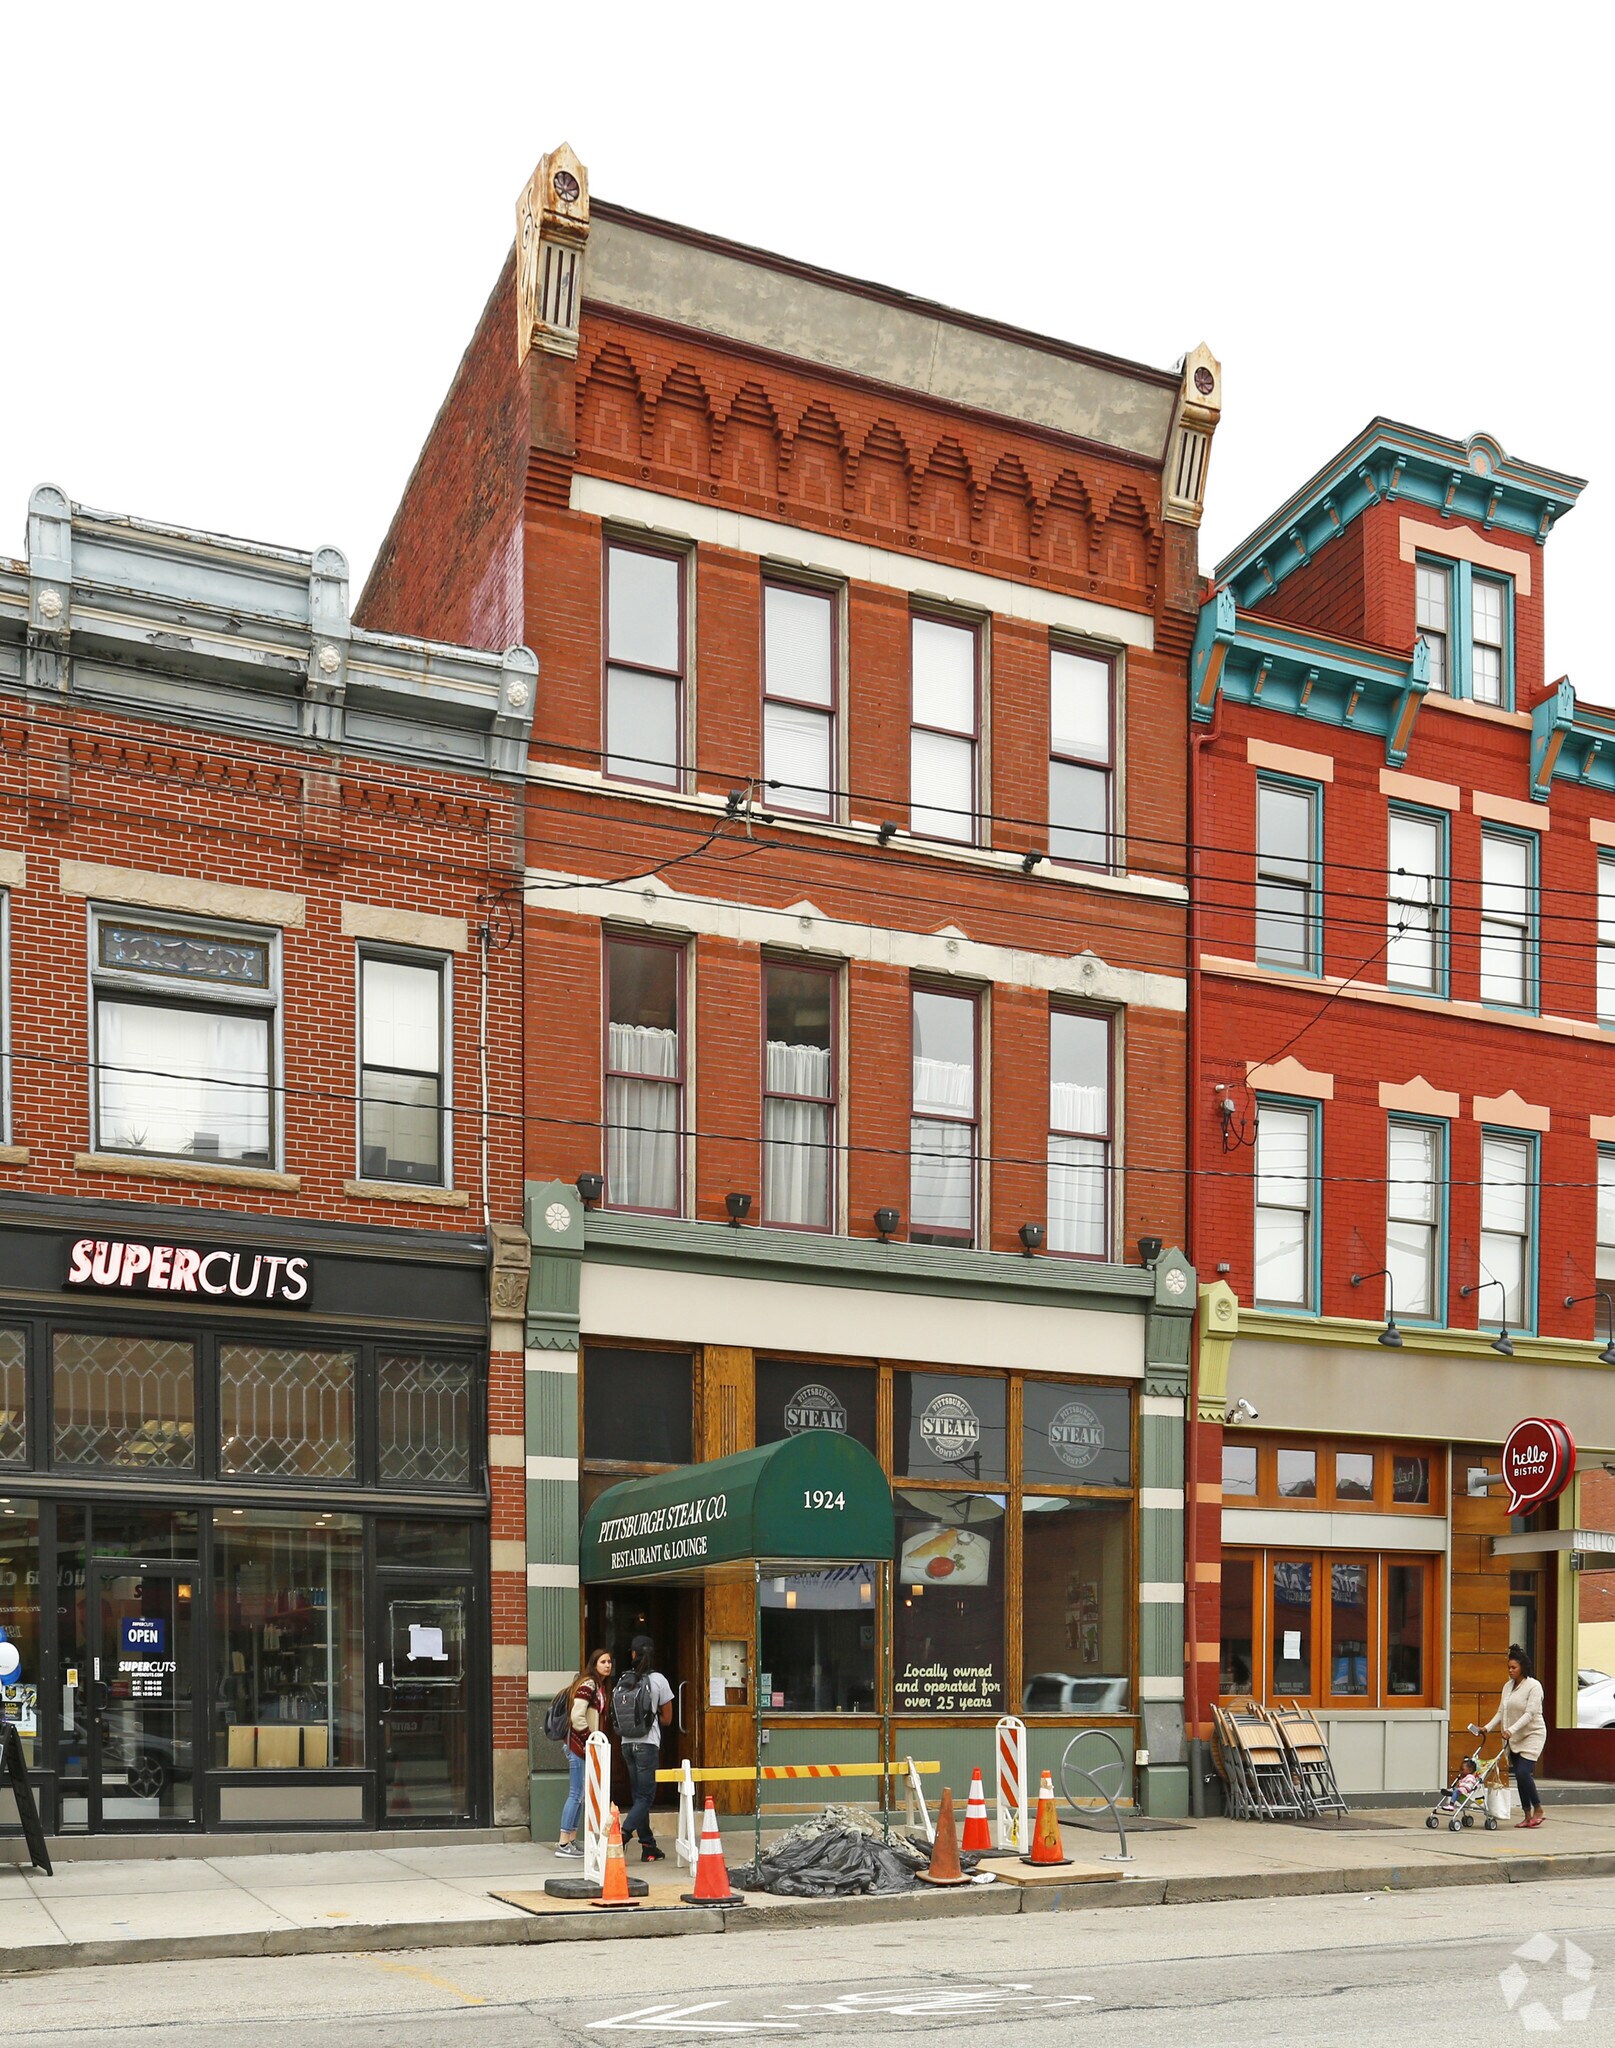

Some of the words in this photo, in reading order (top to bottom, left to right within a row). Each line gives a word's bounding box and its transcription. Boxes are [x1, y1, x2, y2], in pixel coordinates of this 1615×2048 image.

[68, 1238, 309, 1300] SUPERCUTS
[796, 1388, 836, 1406] PITTSBURGH
[932, 1397, 969, 1415] PITTSBURGH
[788, 1408, 844, 1428] STEAK
[1060, 1406, 1095, 1423] PITTSBURGH
[923, 1418, 976, 1436] STEAK
[1052, 1426, 1102, 1444] STEAK
[935, 1445, 965, 1458] COMPANY
[1062, 1452, 1091, 1464] COMPANY
[1512, 1445, 1548, 1466] hello
[1514, 1466, 1545, 1476] BISTRO
[803, 1490, 846, 1511] 1924
[598, 1511, 666, 1544] PITTSBURGH
[666, 1500, 704, 1528] STEAK
[706, 1494, 728, 1522] CO.
[1576, 1532, 1614, 1551] HELLO
[611, 1544, 662, 1569] RESTAURANT
[663, 1544, 671, 1557] &
[672, 1536, 708, 1558] LOUNGE
[128, 1628, 158, 1643] OPEN
[118, 1661, 176, 1672] SUPERCUTS
[904, 1664, 948, 1680] Locally
[953, 1664, 992, 1677] owned
[894, 1678, 919, 1692] and
[924, 1678, 976, 1696] operated
[982, 1678, 1000, 1696] for
[904, 1698, 932, 1707] over
[936, 1696, 954, 1710] 25
[960, 1698, 992, 1711] years
